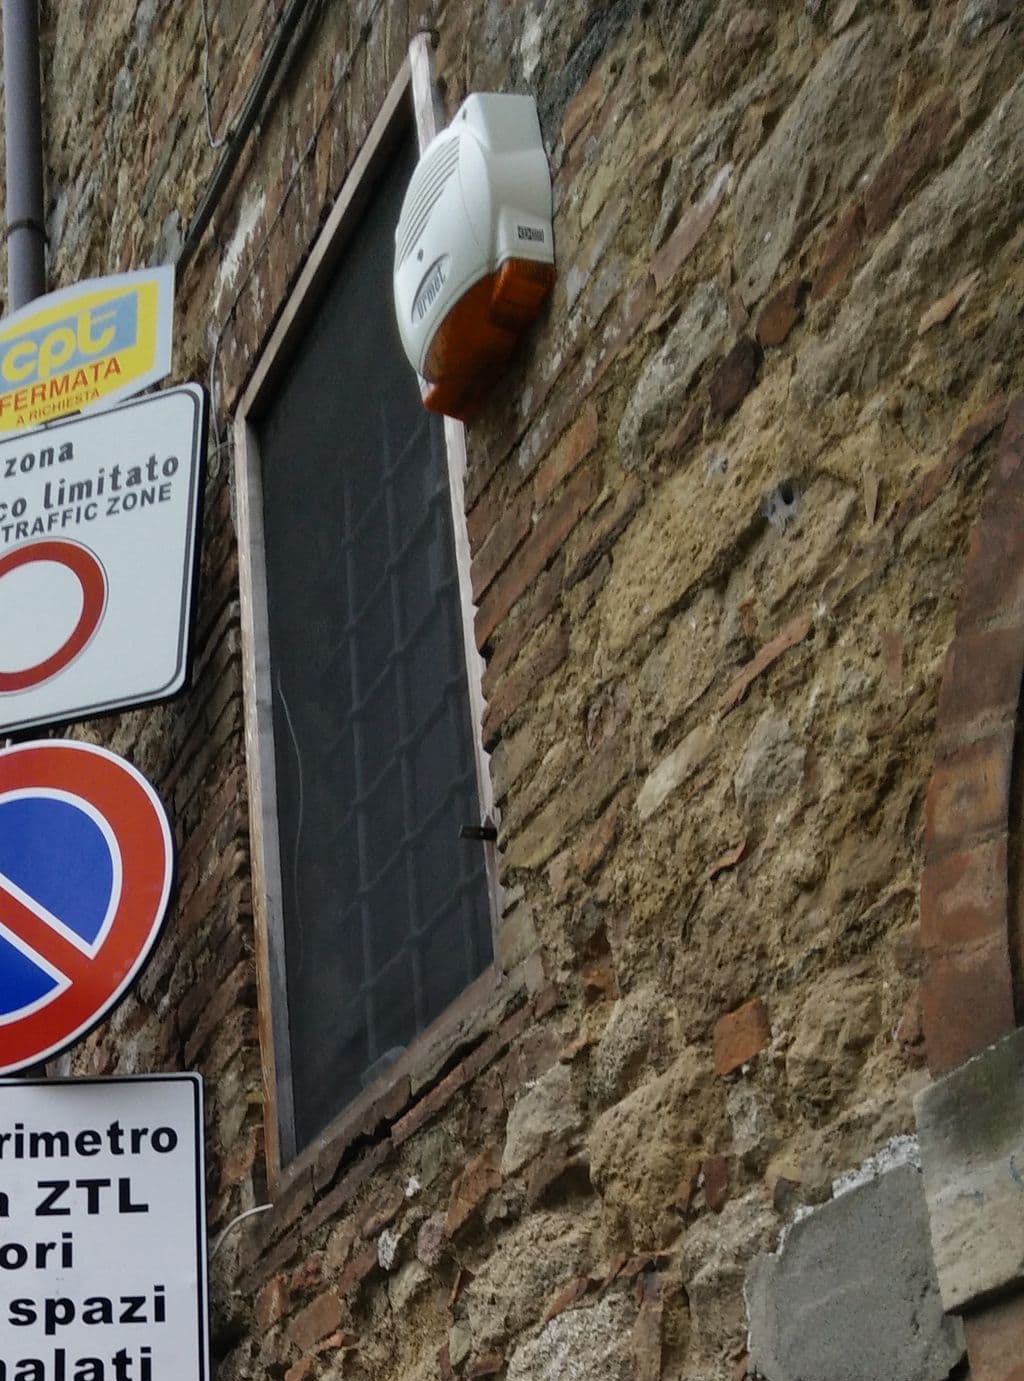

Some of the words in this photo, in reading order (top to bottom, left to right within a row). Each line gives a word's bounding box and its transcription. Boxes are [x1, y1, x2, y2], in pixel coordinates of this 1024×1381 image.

[0, 307, 118, 383] cpt
[17, 415, 25, 425] A
[29, 389, 100, 422] RICHIESTA
[3, 441, 74, 479] zona
[43, 454, 179, 510] limitato
[1, 501, 98, 543] TRAFFIC
[106, 481, 173, 517] ZONE
[34, 1177, 149, 1217] ZTL
[7, 1284, 166, 1336] spazi
